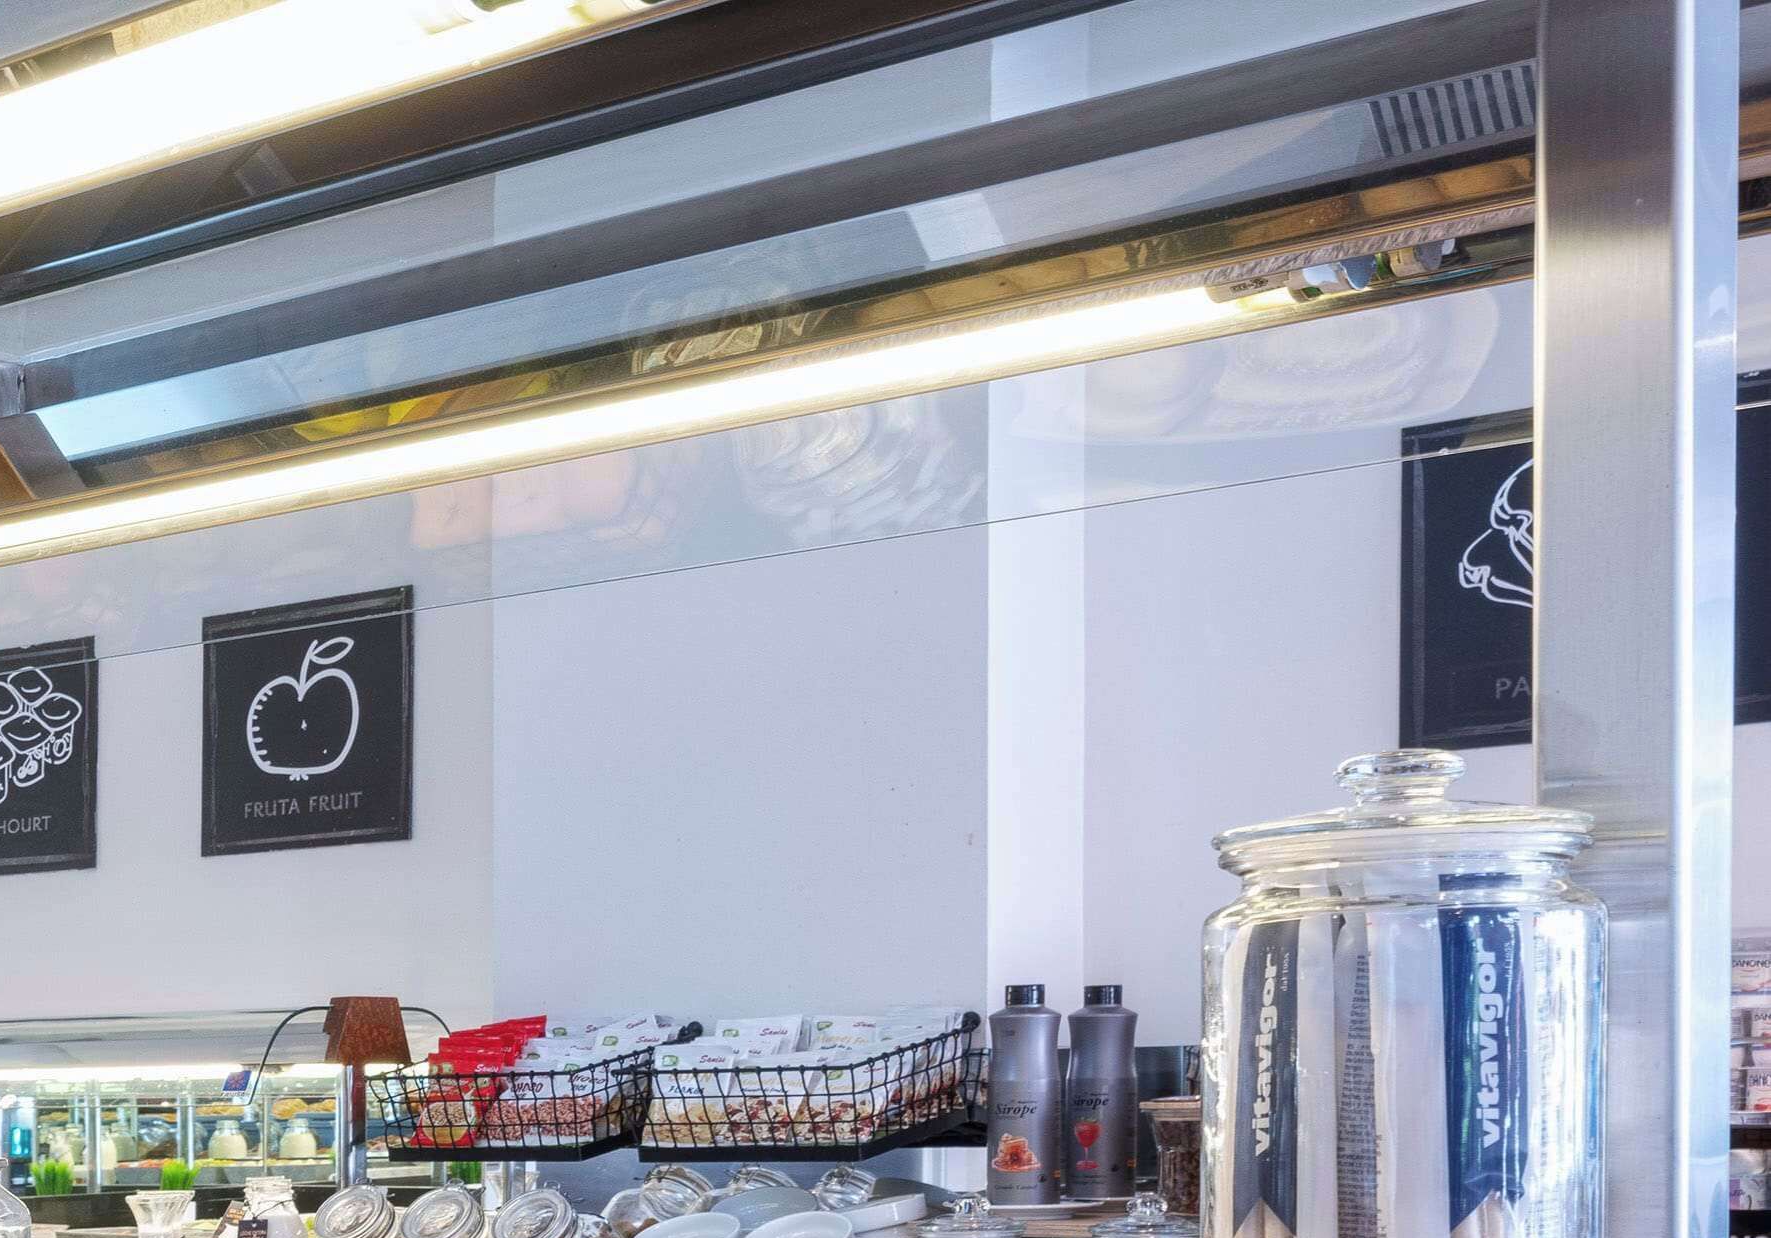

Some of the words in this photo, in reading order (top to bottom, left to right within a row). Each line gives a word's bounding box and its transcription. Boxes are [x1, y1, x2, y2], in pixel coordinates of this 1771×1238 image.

[243, 798, 301, 819] FRUTA
[308, 791, 364, 813] FRUIT
[1251, 953, 1277, 1157] vitavigor
[1475, 938, 1504, 1148] vitavigor
[995, 1102, 1037, 1118] Sirope
